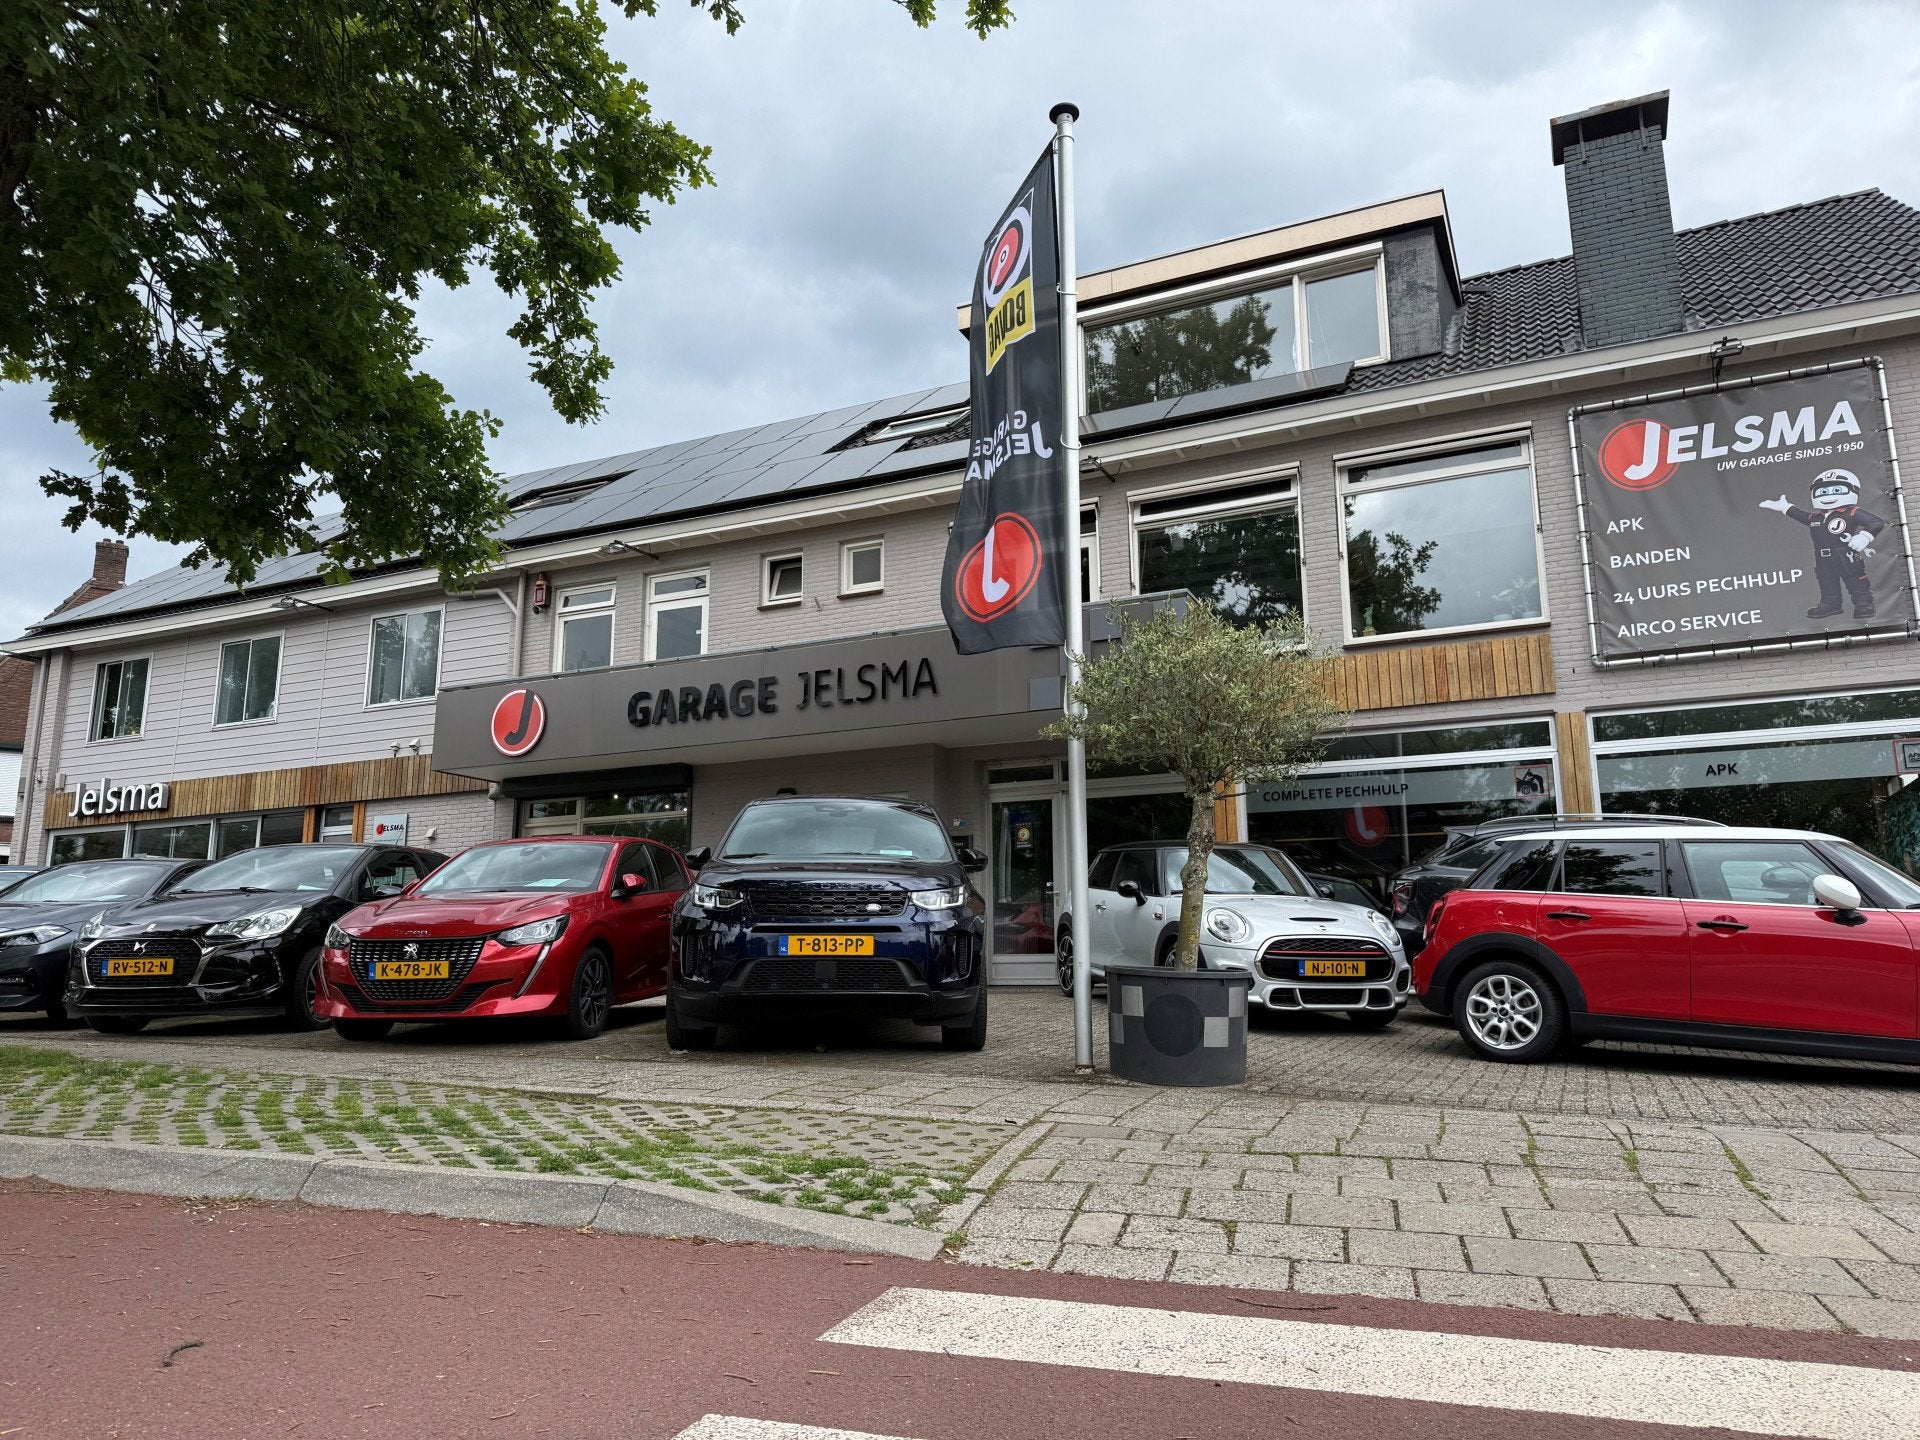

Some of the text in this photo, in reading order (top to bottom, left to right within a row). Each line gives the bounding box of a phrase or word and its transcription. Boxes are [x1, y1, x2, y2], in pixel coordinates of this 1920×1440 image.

[1623, 400, 1862, 481] JELSMA
[1717, 441, 1864, 471] UW GARAGE SINDS 1950
[1606, 517, 1645, 534] APK
[1610, 546, 1691, 569] BANDEN
[1613, 569, 1803, 605] 24 UURS PECHHULP
[1617, 610, 1763, 638] AIRCO SERVICE
[627, 657, 938, 728] GARAGE JELSMA
[1705, 762, 1738, 776] APK
[68, 777, 165, 817] Jelsma
[1262, 783, 1409, 802] COMPLETE PECHHULP
[796, 938, 865, 952] T-813-PP
[113, 961, 168, 973] RV-512-N
[381, 963, 442, 976] K-478-JK
[1312, 962, 1359, 974] NJ-101-N
